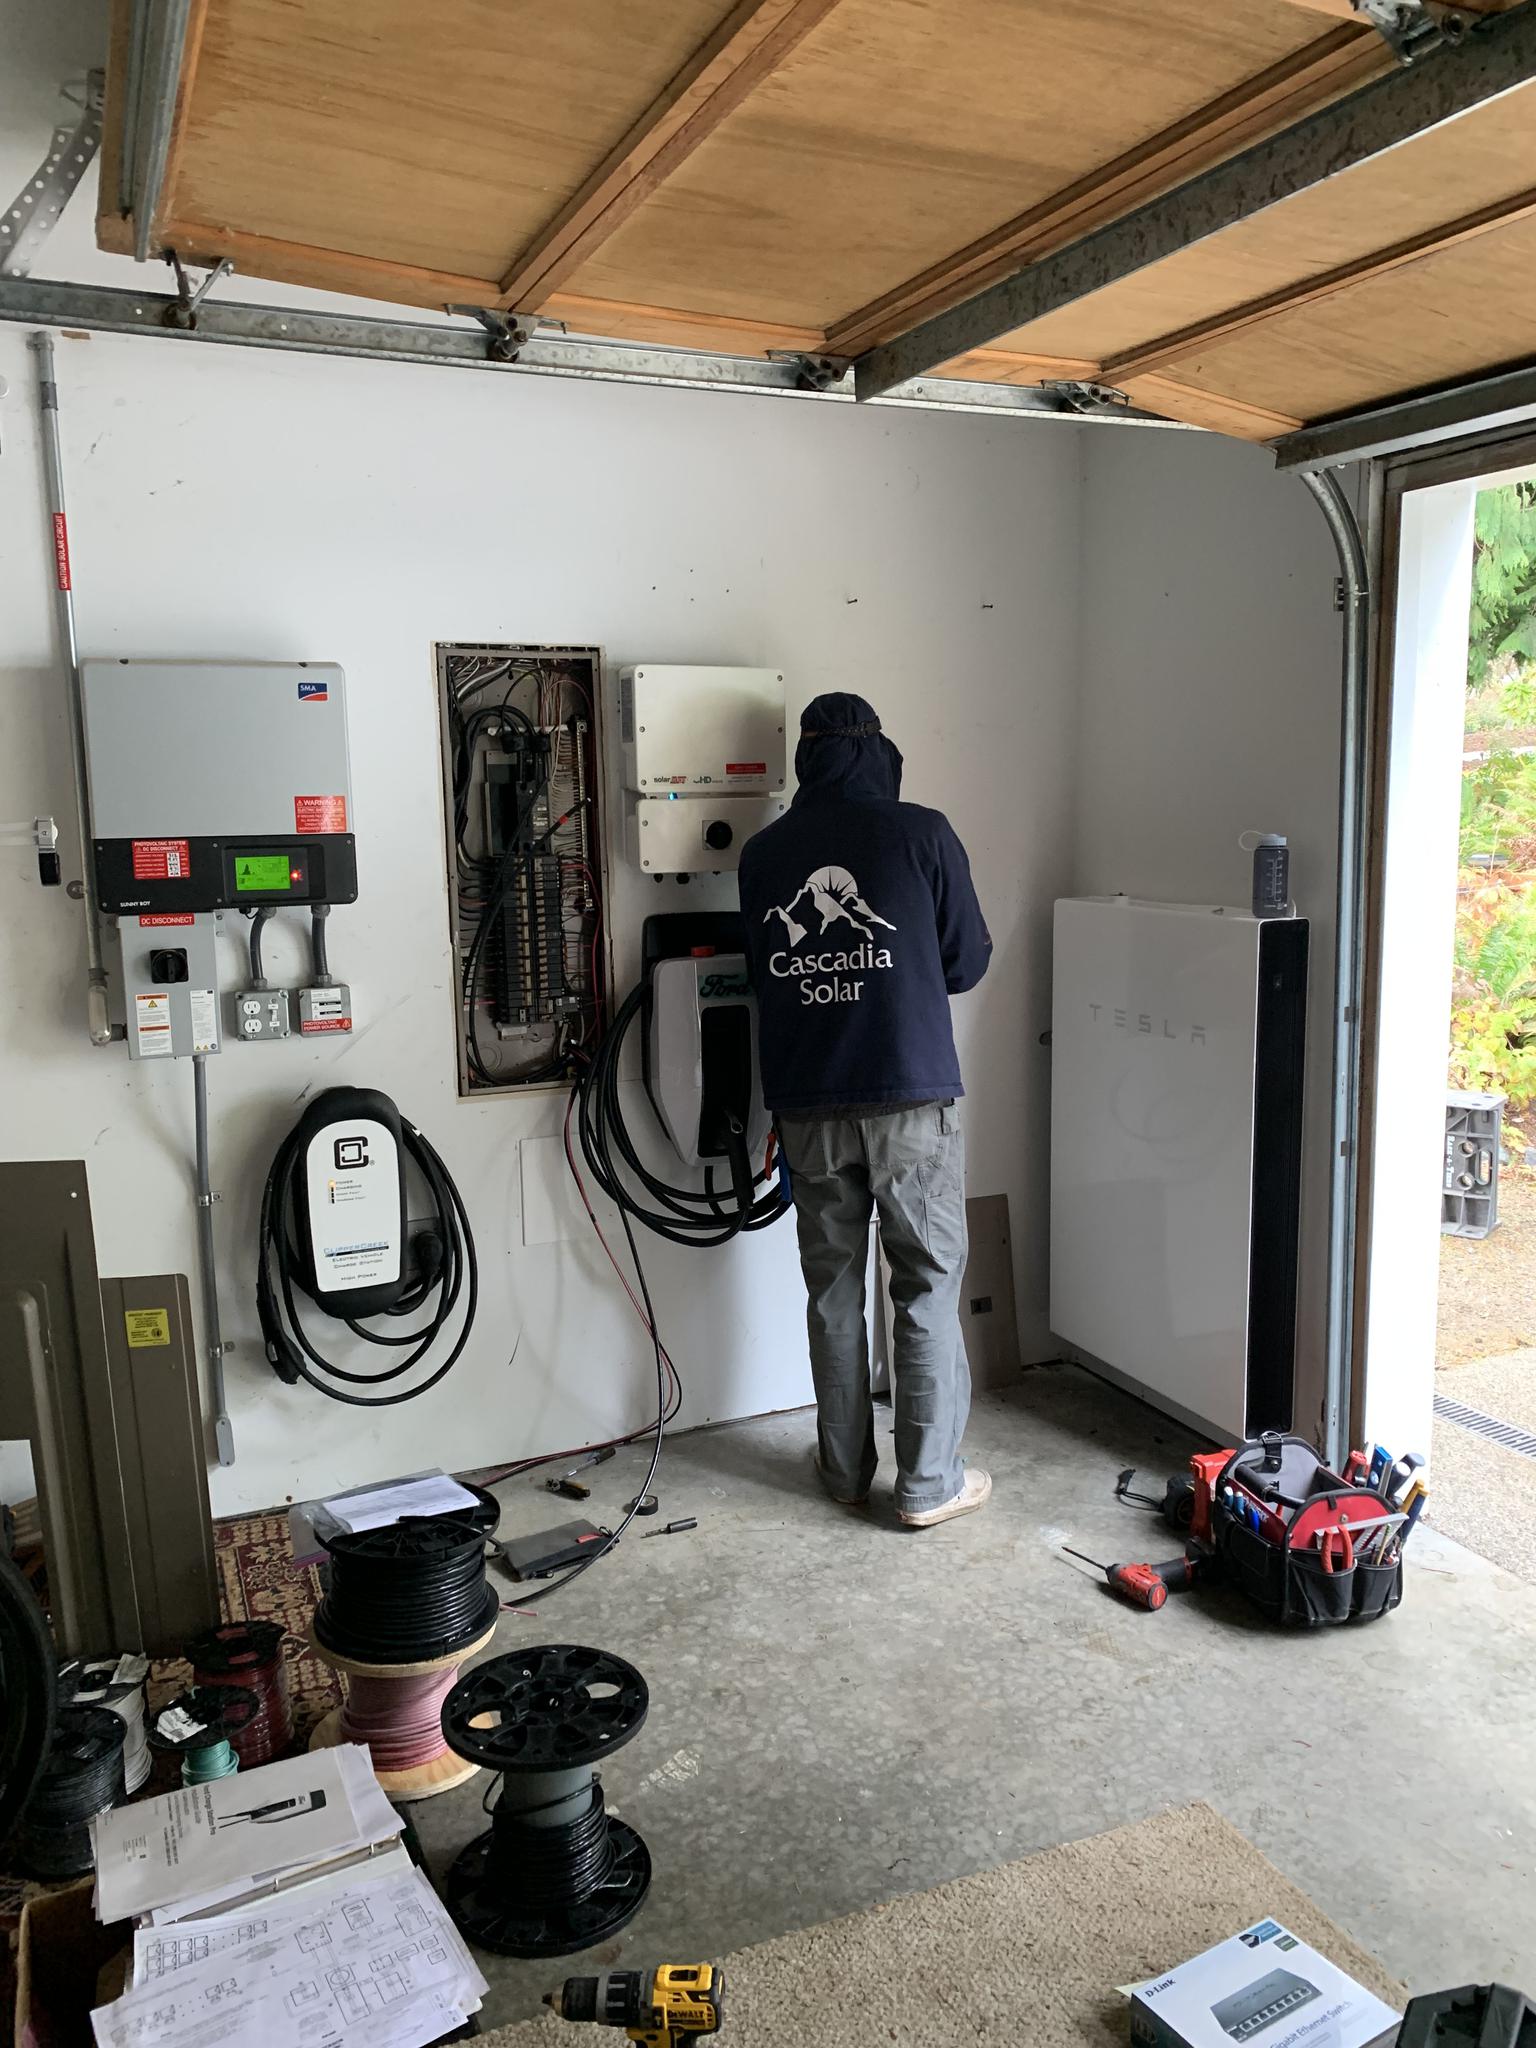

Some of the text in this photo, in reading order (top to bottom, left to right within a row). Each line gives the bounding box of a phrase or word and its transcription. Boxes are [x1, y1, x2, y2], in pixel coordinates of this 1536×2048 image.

[55, 515, 68, 589] CAUTION SOLAR CIRCUIT
[152, 916, 193, 925] DISCONNECT
[769, 943, 894, 978] Cascadia
[799, 976, 865, 1005] Solar
[1089, 1003, 1206, 1047] TESLA
[1144, 1979, 1177, 1998] D-Link
[1296, 2014, 1330, 2036] Ethernet
[1326, 2000, 1353, 2018] Switch
